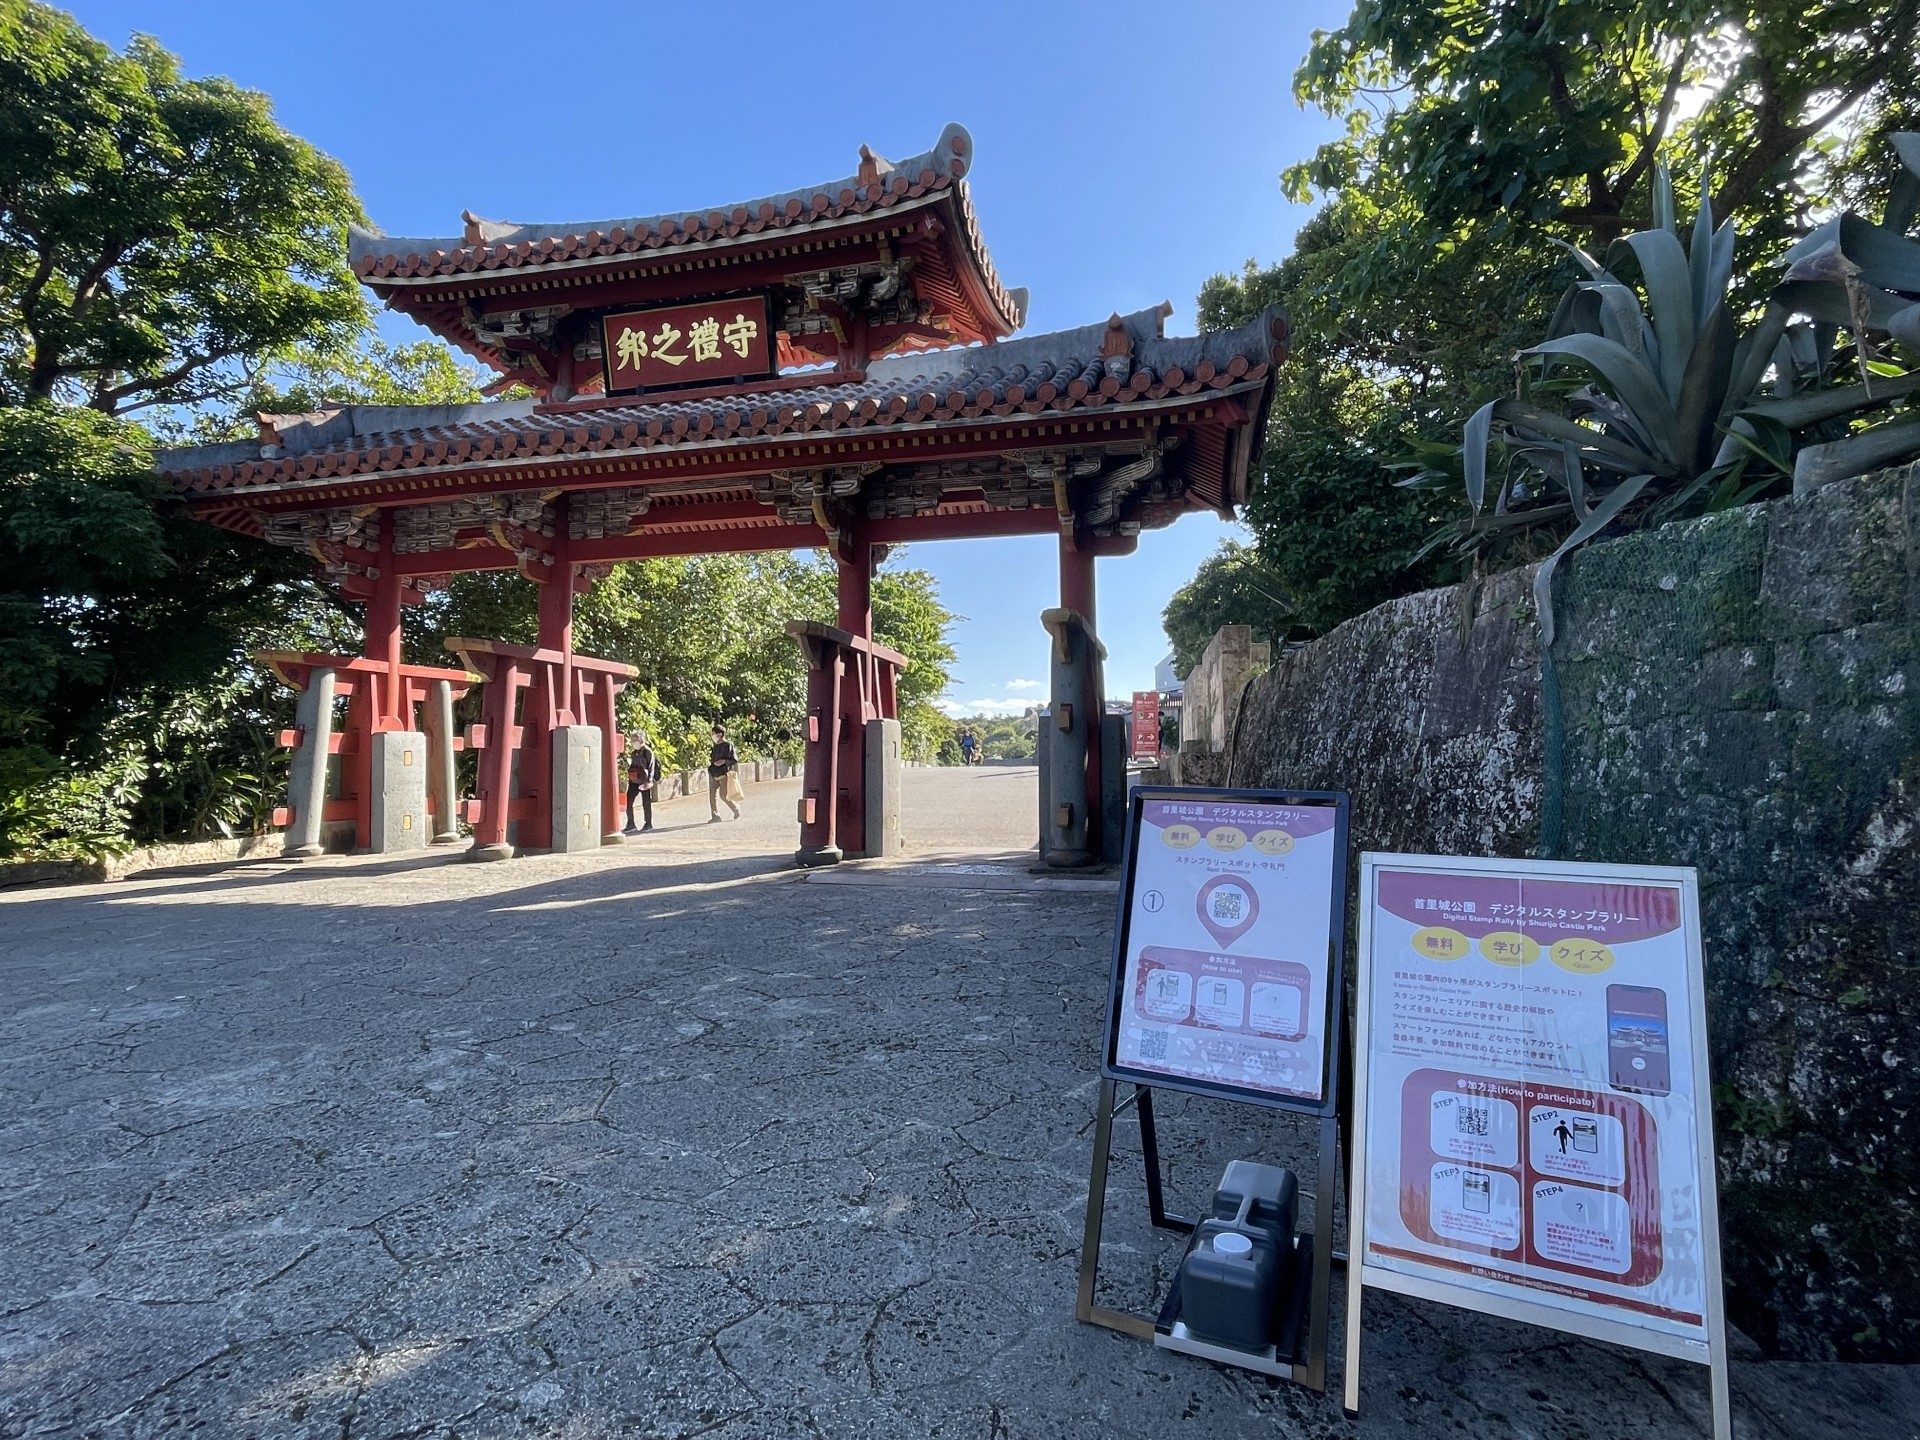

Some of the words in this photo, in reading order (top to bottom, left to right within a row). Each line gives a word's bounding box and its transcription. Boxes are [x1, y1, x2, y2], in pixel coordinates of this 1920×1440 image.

[1162, 805, 1204, 816] 首里城公園
[1212, 807, 1311, 821] デジタルスタンプラリー
[1170, 831, 1190, 842] 無料
[1215, 833, 1236, 844] 学び
[1258, 836, 1289, 847] クイズ
[1414, 898, 1476, 912] 首里城公園
[1490, 903, 1640, 923] デジタルスタンプラリー
[1443, 912, 1468, 922] Digital
[1469, 915, 1494, 924] Stamp
[1495, 916, 1515, 926] Rally
[1516, 918, 1526, 927] by
[1528, 919, 1558, 929] Shurijo
[1559, 921, 1585, 930] Castle
[1587, 923, 1606, 931] Park
[1425, 936, 1453, 951] 無料
[1492, 940, 1523, 955] 学び
[1557, 946, 1605, 962] クイズ
[1201, 964, 1218, 972] (How
[1228, 967, 1243, 975] use)
[1524, 1090, 1534, 1098] to
[1537, 1091, 1596, 1109] participate)
